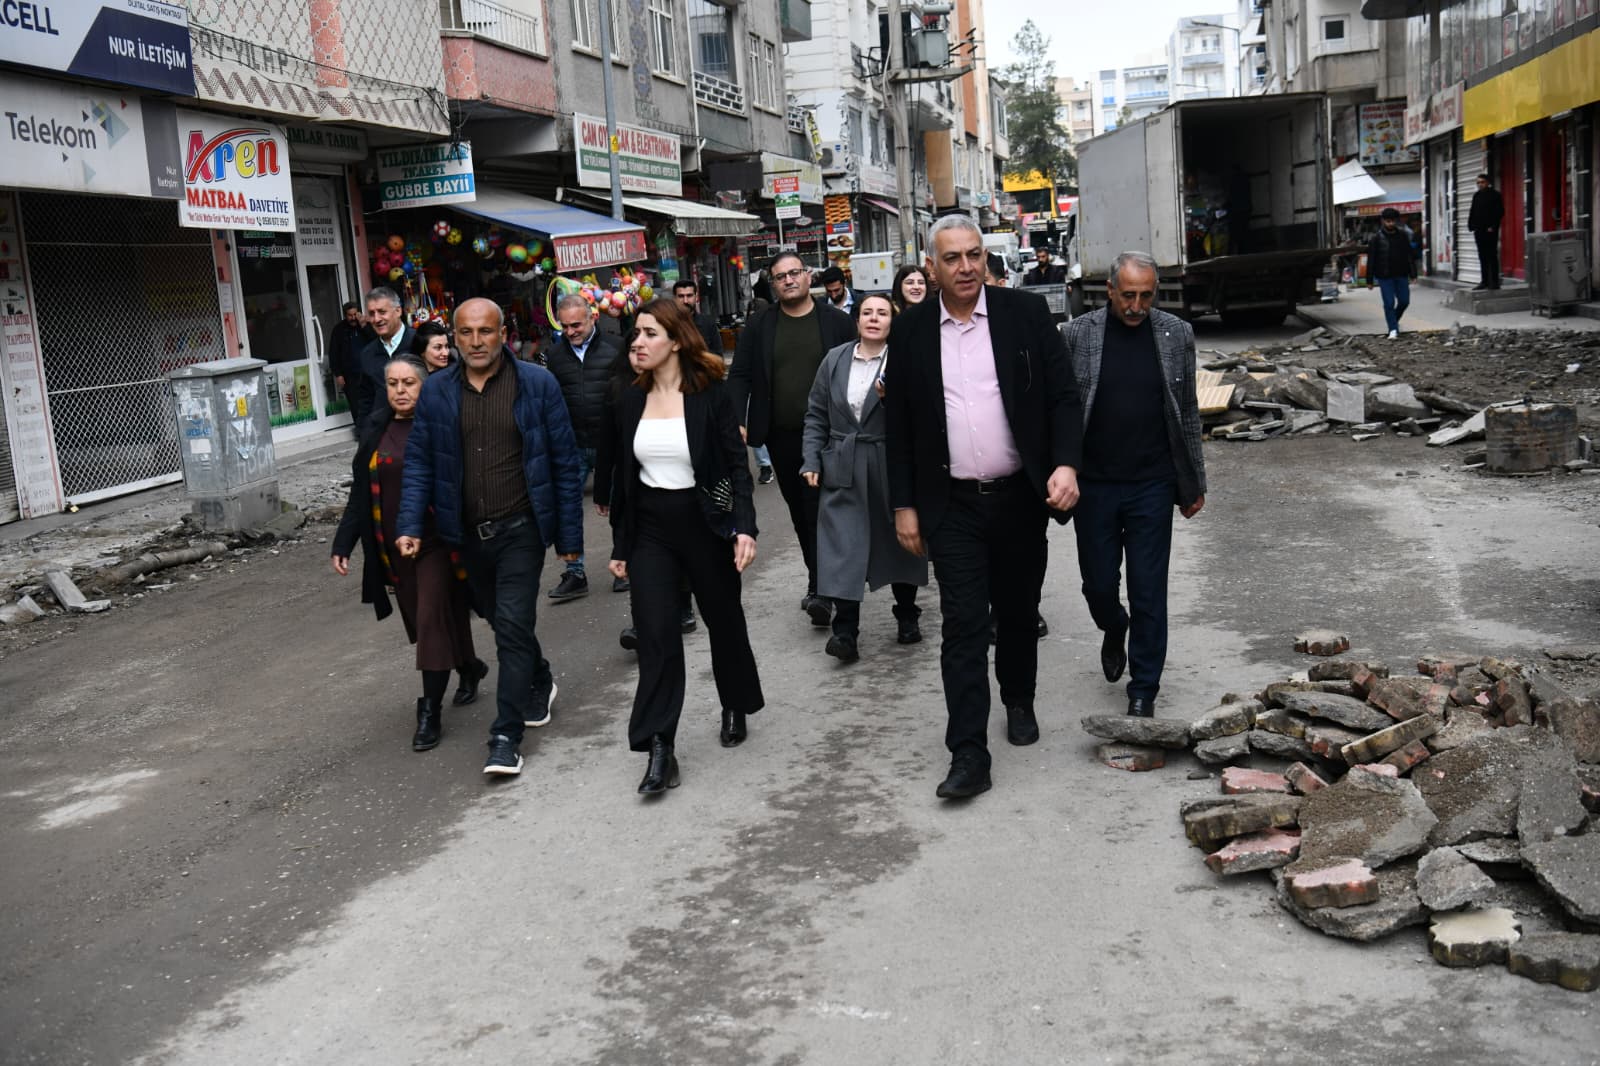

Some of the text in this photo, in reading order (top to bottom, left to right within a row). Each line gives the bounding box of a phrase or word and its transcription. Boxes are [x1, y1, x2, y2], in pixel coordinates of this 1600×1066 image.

[108, 35, 187, 70] NUR İLETİŞİM
[5, 111, 97, 150] Telekom
[326, 131, 360, 151] TARIM
[184, 127, 281, 185] Aren
[433, 174, 470, 194] BAYİİ
[186, 187, 289, 214] MATBAA DAVETİYE
[556, 239, 627, 268] YÜKSEL MARKET
